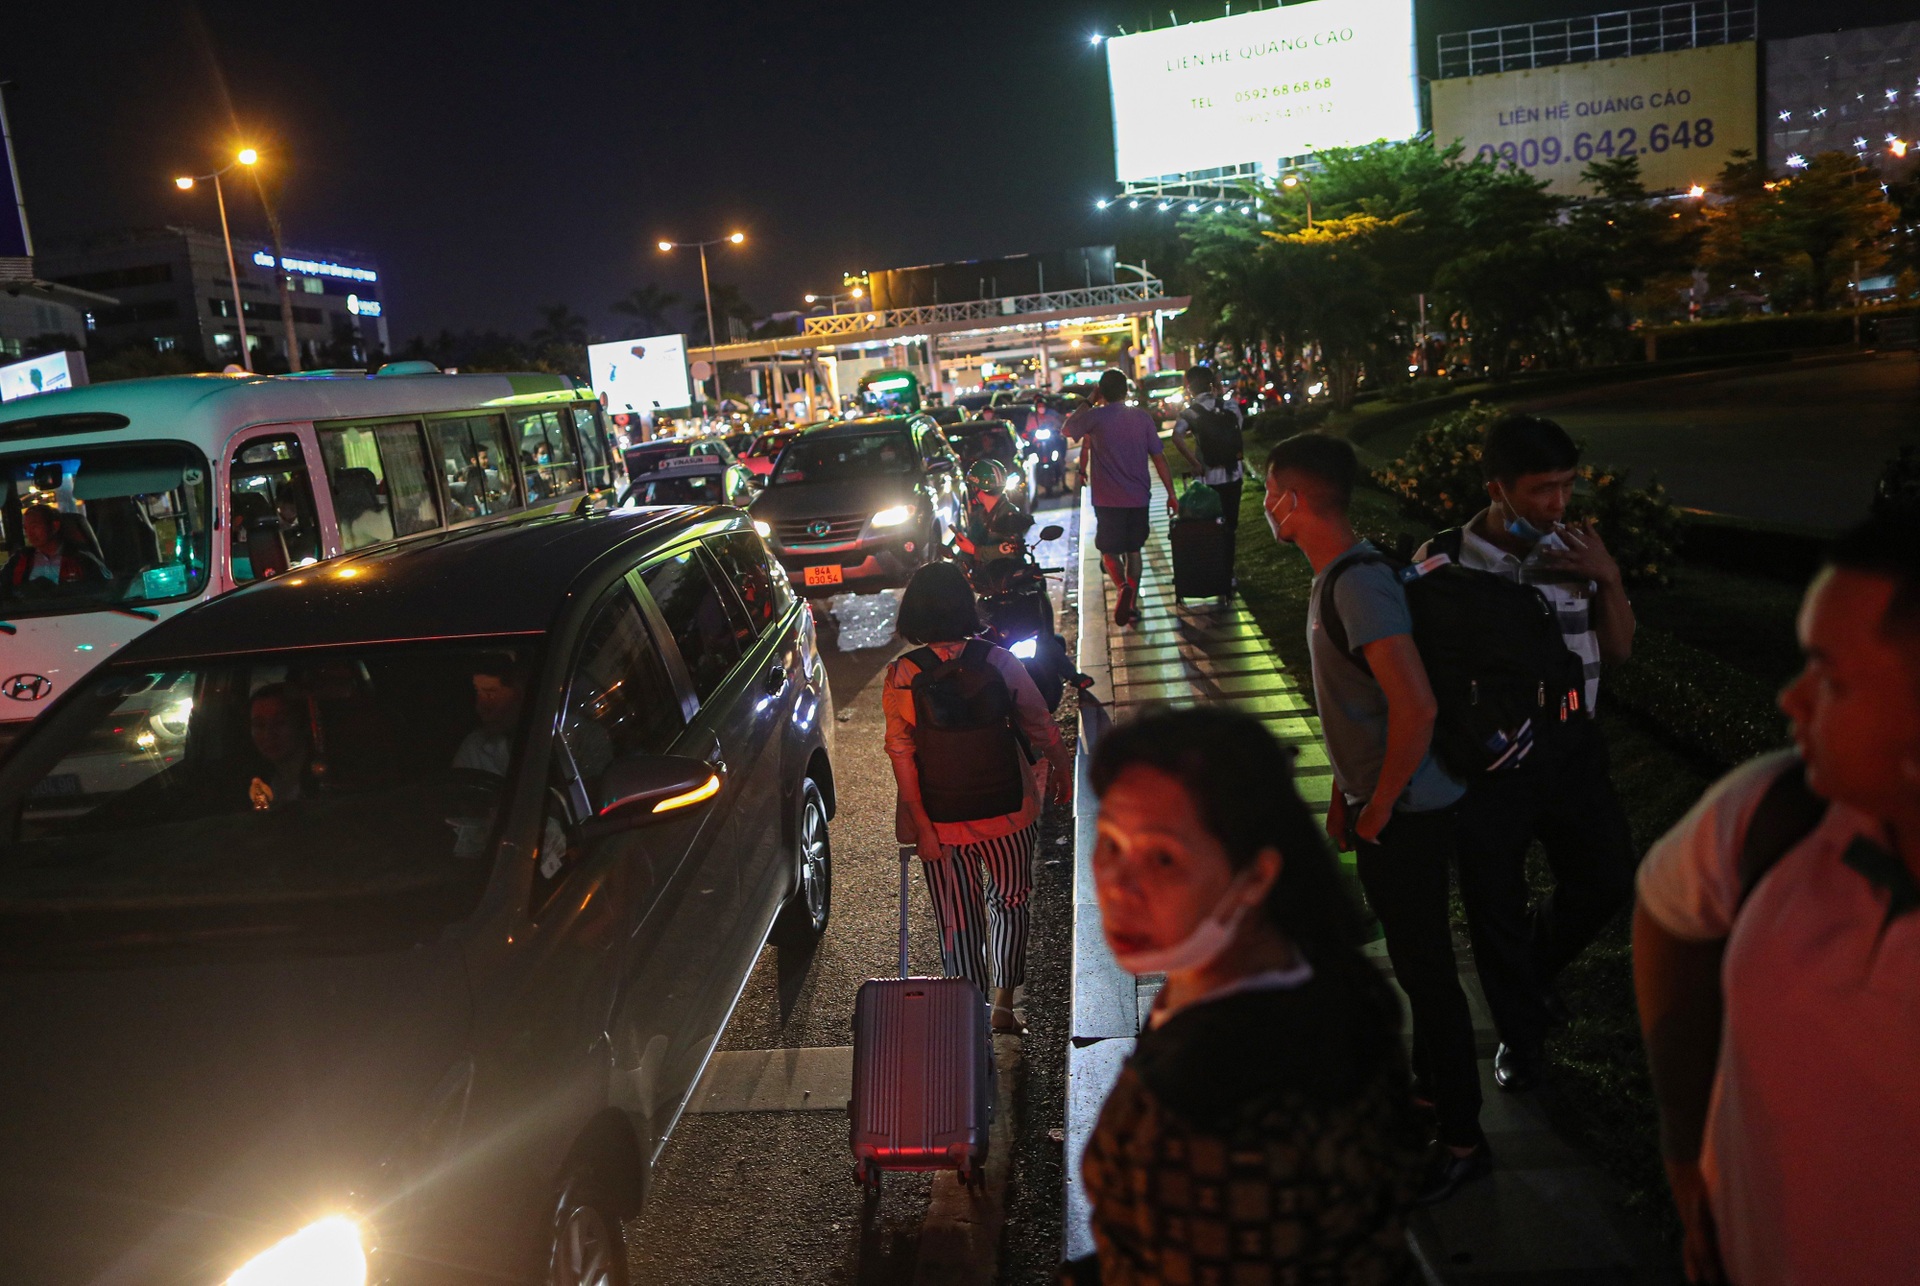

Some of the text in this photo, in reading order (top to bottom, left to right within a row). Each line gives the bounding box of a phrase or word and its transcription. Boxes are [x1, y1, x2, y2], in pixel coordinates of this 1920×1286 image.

[1273, 84, 1290, 97] 68
[1293, 80, 1311, 94] 68
[1314, 77, 1331, 90] 68
[1498, 105, 1540, 127] LIÊN
[1649, 88, 1692, 108] CÁO
[814, 566, 831, 576] 84A
